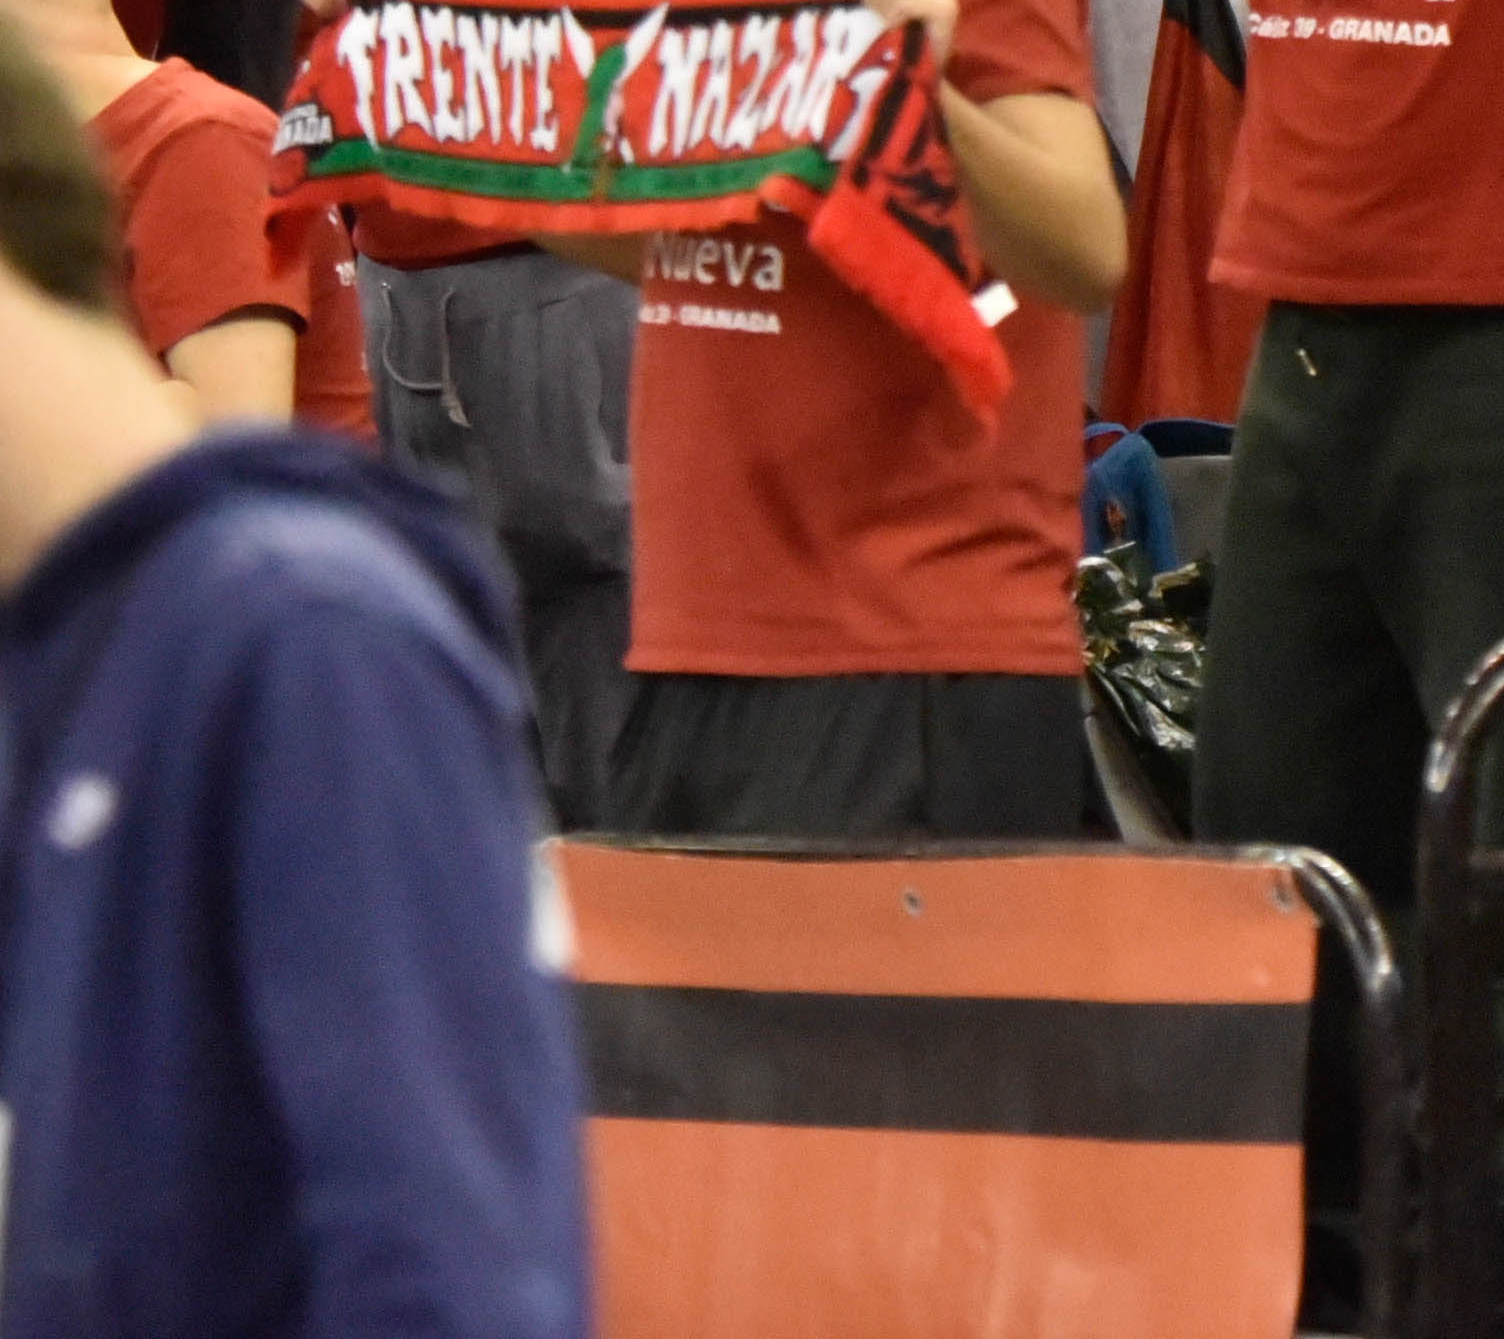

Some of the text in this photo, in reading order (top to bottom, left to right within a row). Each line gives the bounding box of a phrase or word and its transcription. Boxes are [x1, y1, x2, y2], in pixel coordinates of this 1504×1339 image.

[1328, 15, 1452, 46] GRANADA
[338, 1, 561, 151] FRENTE
[646, 232, 784, 292] Nueva
